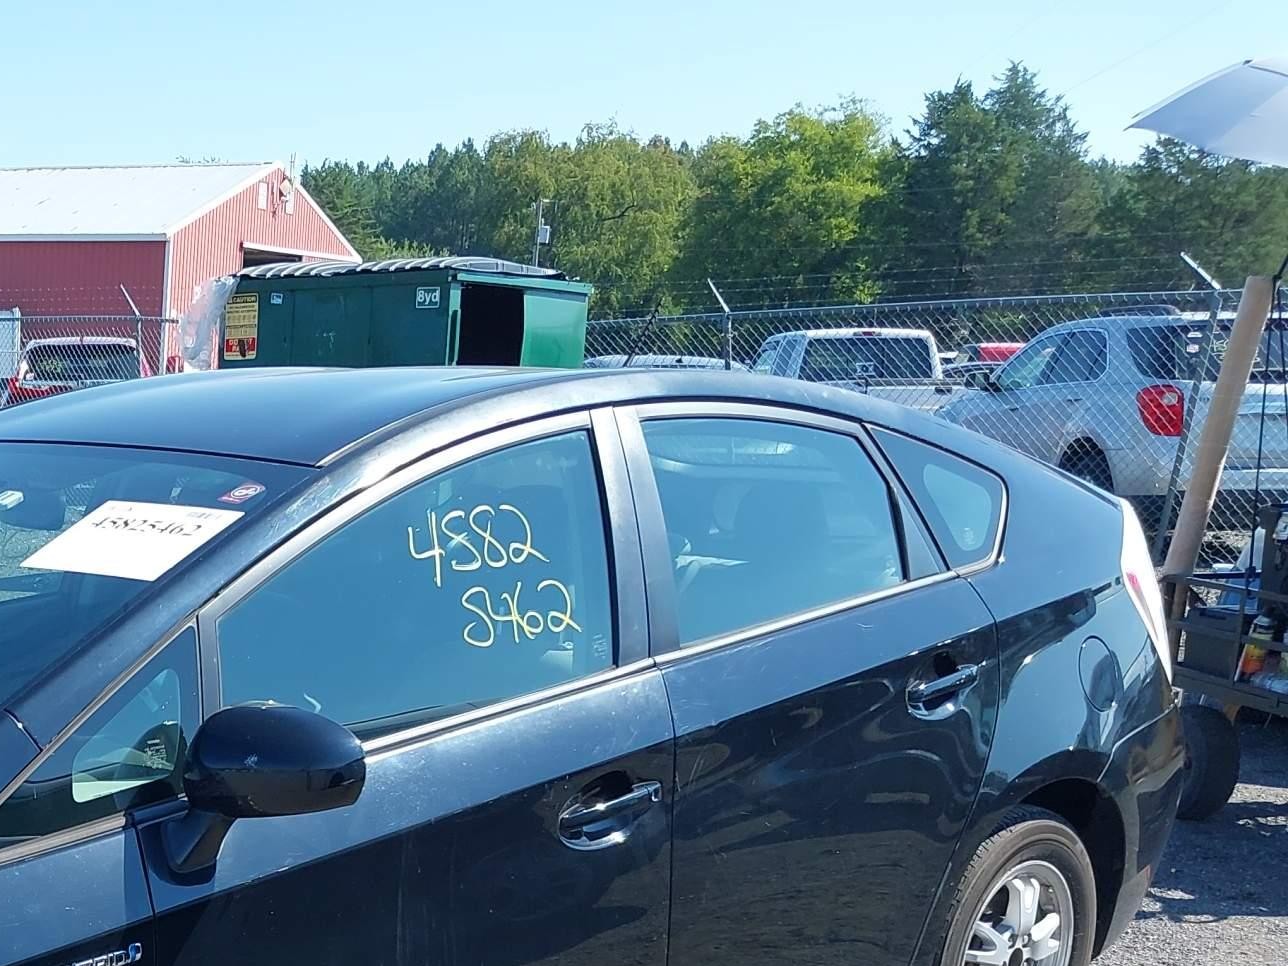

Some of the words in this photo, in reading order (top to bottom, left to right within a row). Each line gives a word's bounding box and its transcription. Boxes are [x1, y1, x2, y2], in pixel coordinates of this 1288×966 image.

[417, 290, 439, 305] 8yd
[91, 516, 202, 536] 45825462
[406, 504, 551, 588] 4582
